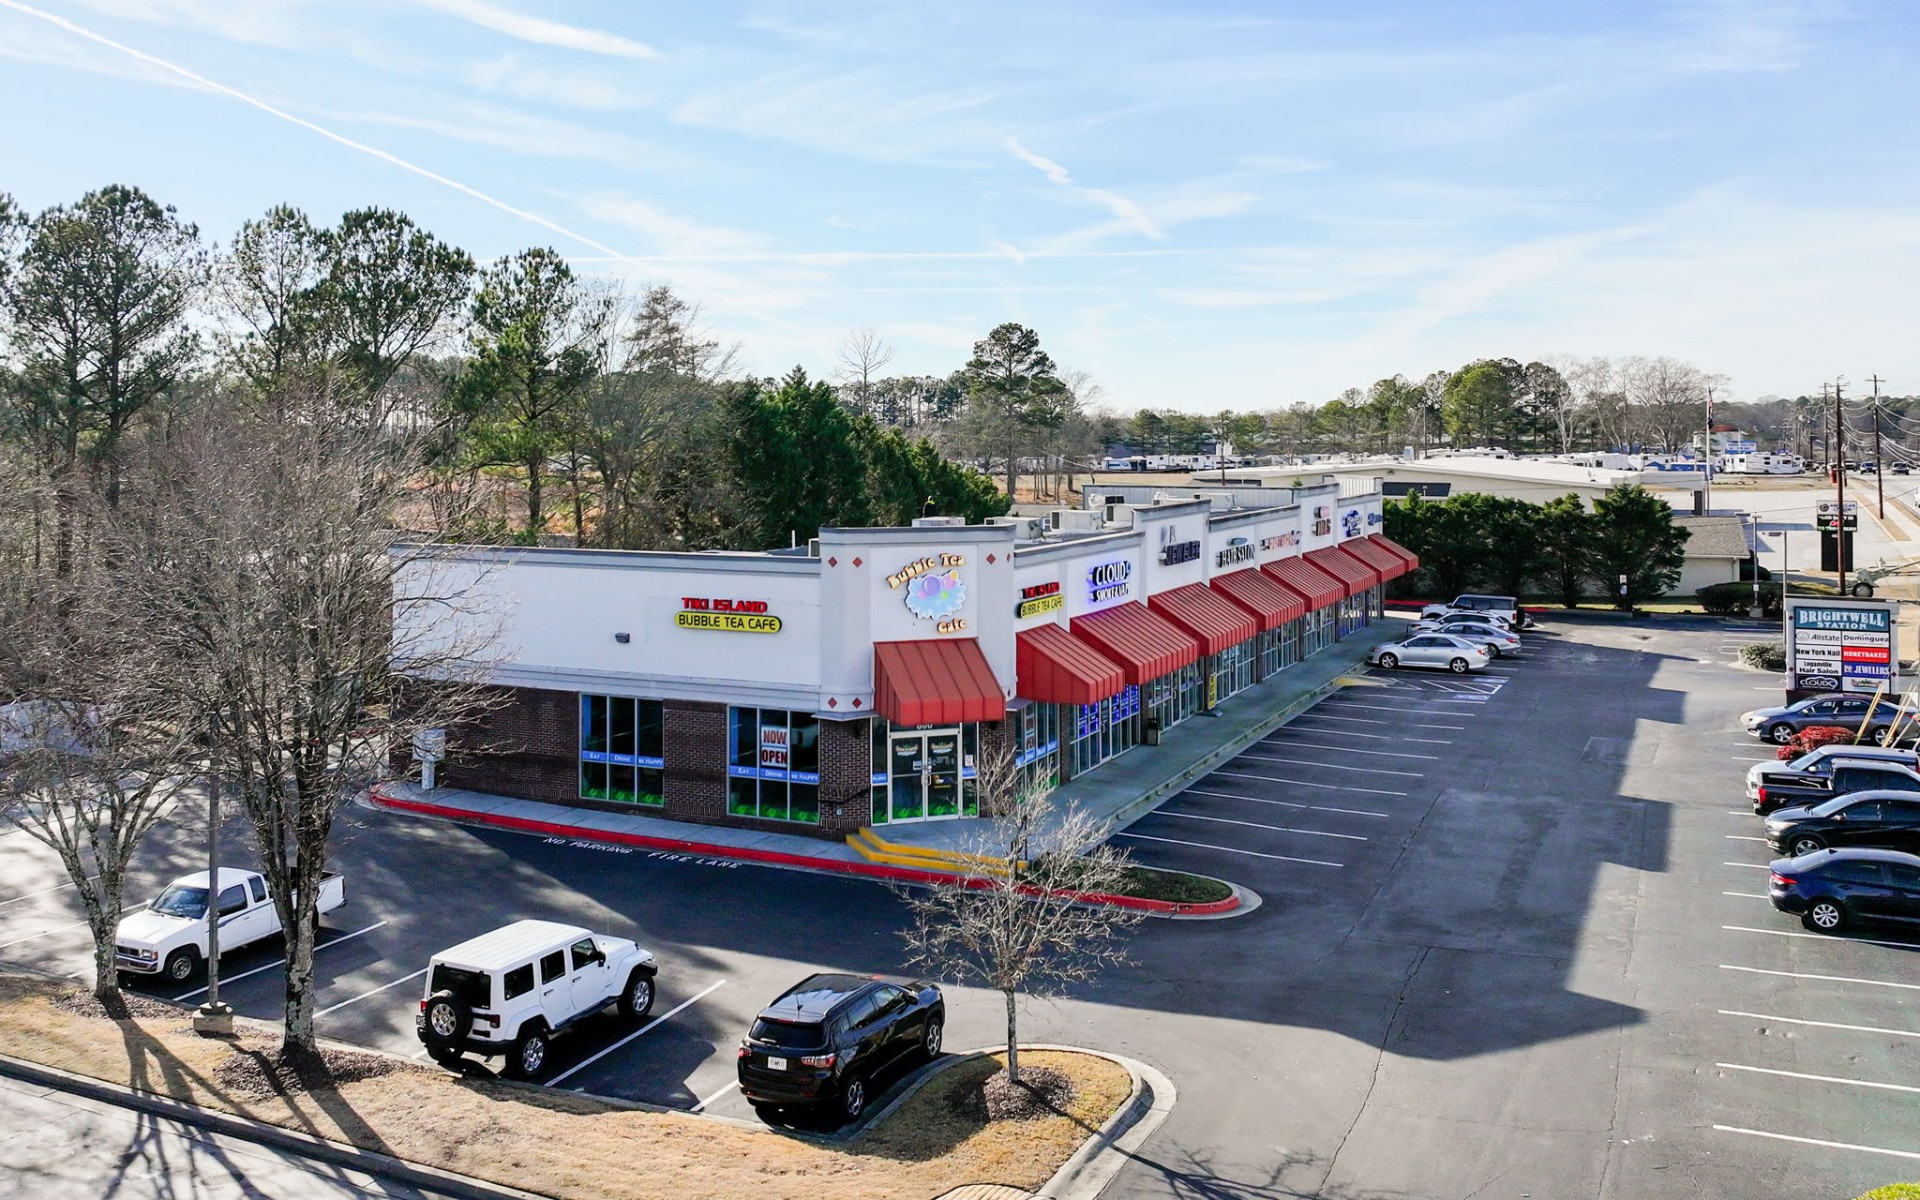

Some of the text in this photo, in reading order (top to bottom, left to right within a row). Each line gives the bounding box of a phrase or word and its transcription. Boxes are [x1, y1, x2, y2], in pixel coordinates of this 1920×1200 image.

[886, 553, 965, 589] Bubble Tea
[681, 598, 768, 613] TIKI ISLAND
[1022, 597, 1062, 616] BUBBLE TEA CAFE
[679, 614, 776, 630] BUBBLE TEA CAFE
[937, 618, 967, 634] Cafe
[1800, 610, 1884, 627] BRIGHTWELL
[763, 730, 787, 744] NOW
[762, 750, 788, 763] OPEN
[543, 837, 743, 869] NO PARKING FIRE LANE
